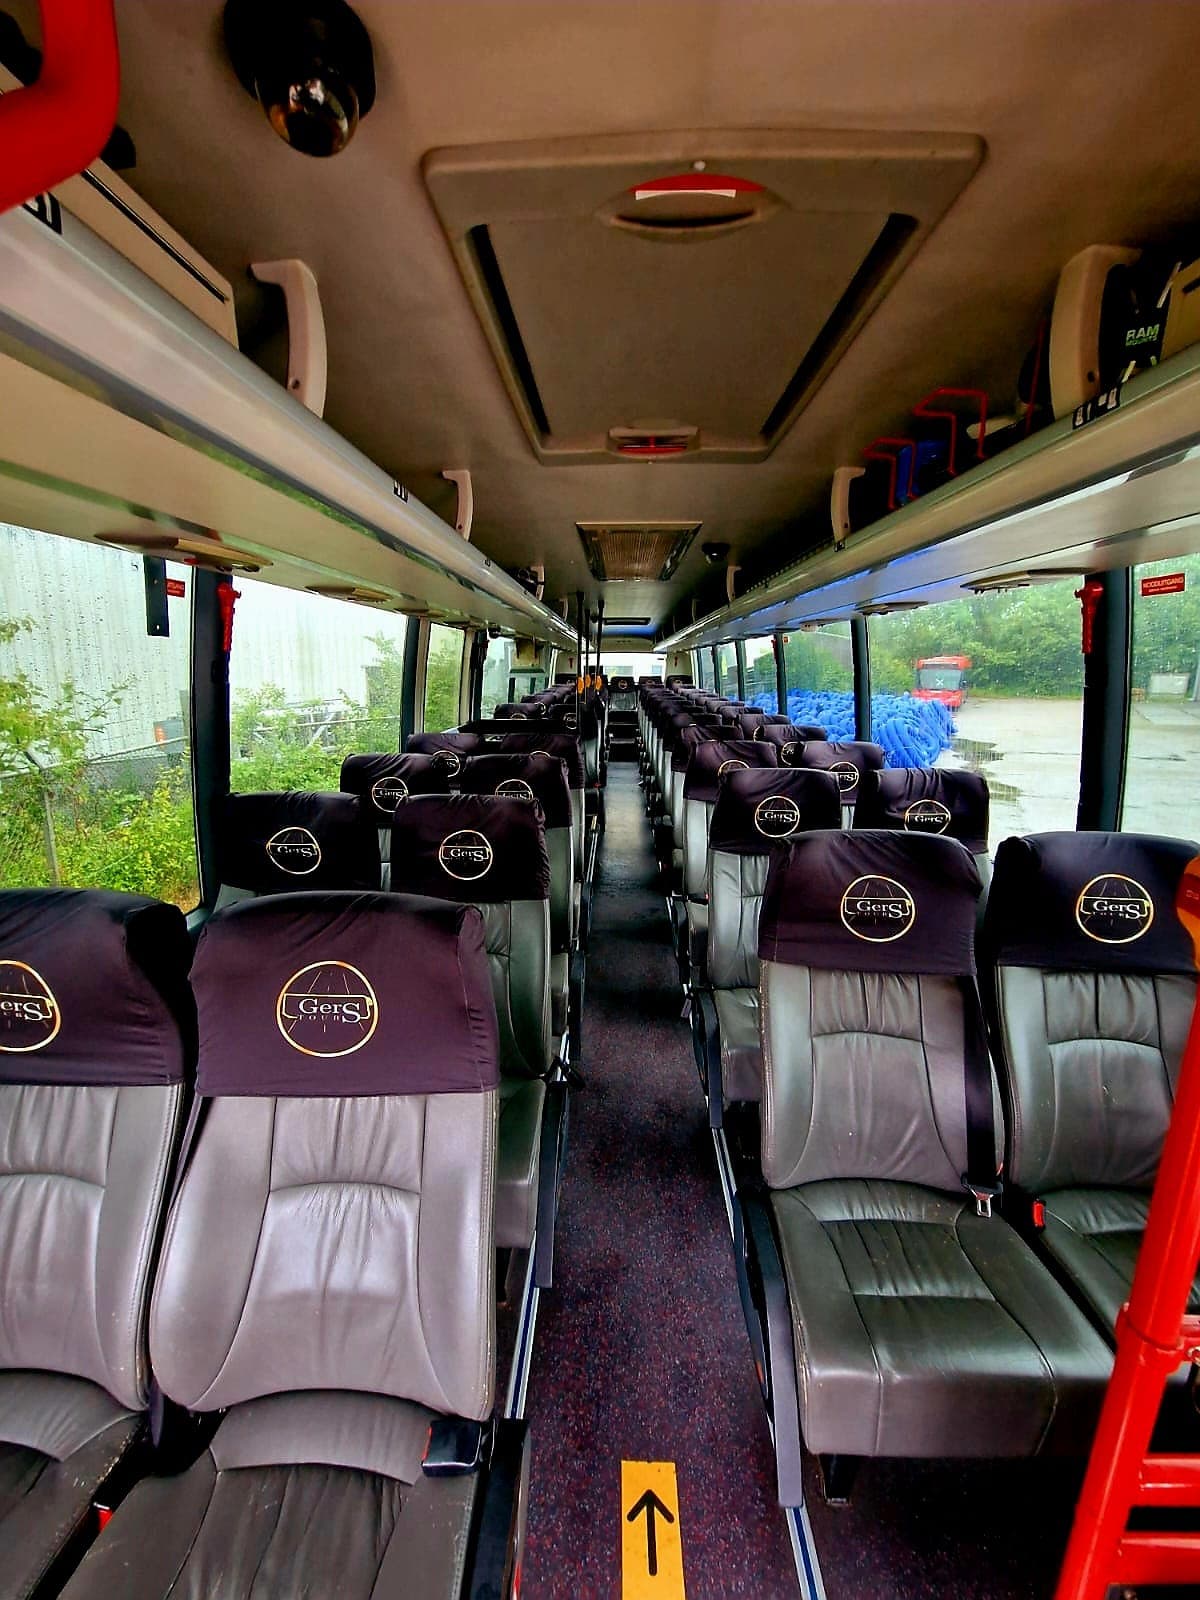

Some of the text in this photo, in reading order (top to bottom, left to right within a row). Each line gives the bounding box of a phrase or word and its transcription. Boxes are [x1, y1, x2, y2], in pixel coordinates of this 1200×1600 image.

[1125, 323, 1160, 341] RAM
[856, 900, 902, 919] GerS
[1093, 900, 1140, 920] GerS
[0, 1001, 43, 1021] erS
[299, 998, 361, 1023] GerS
